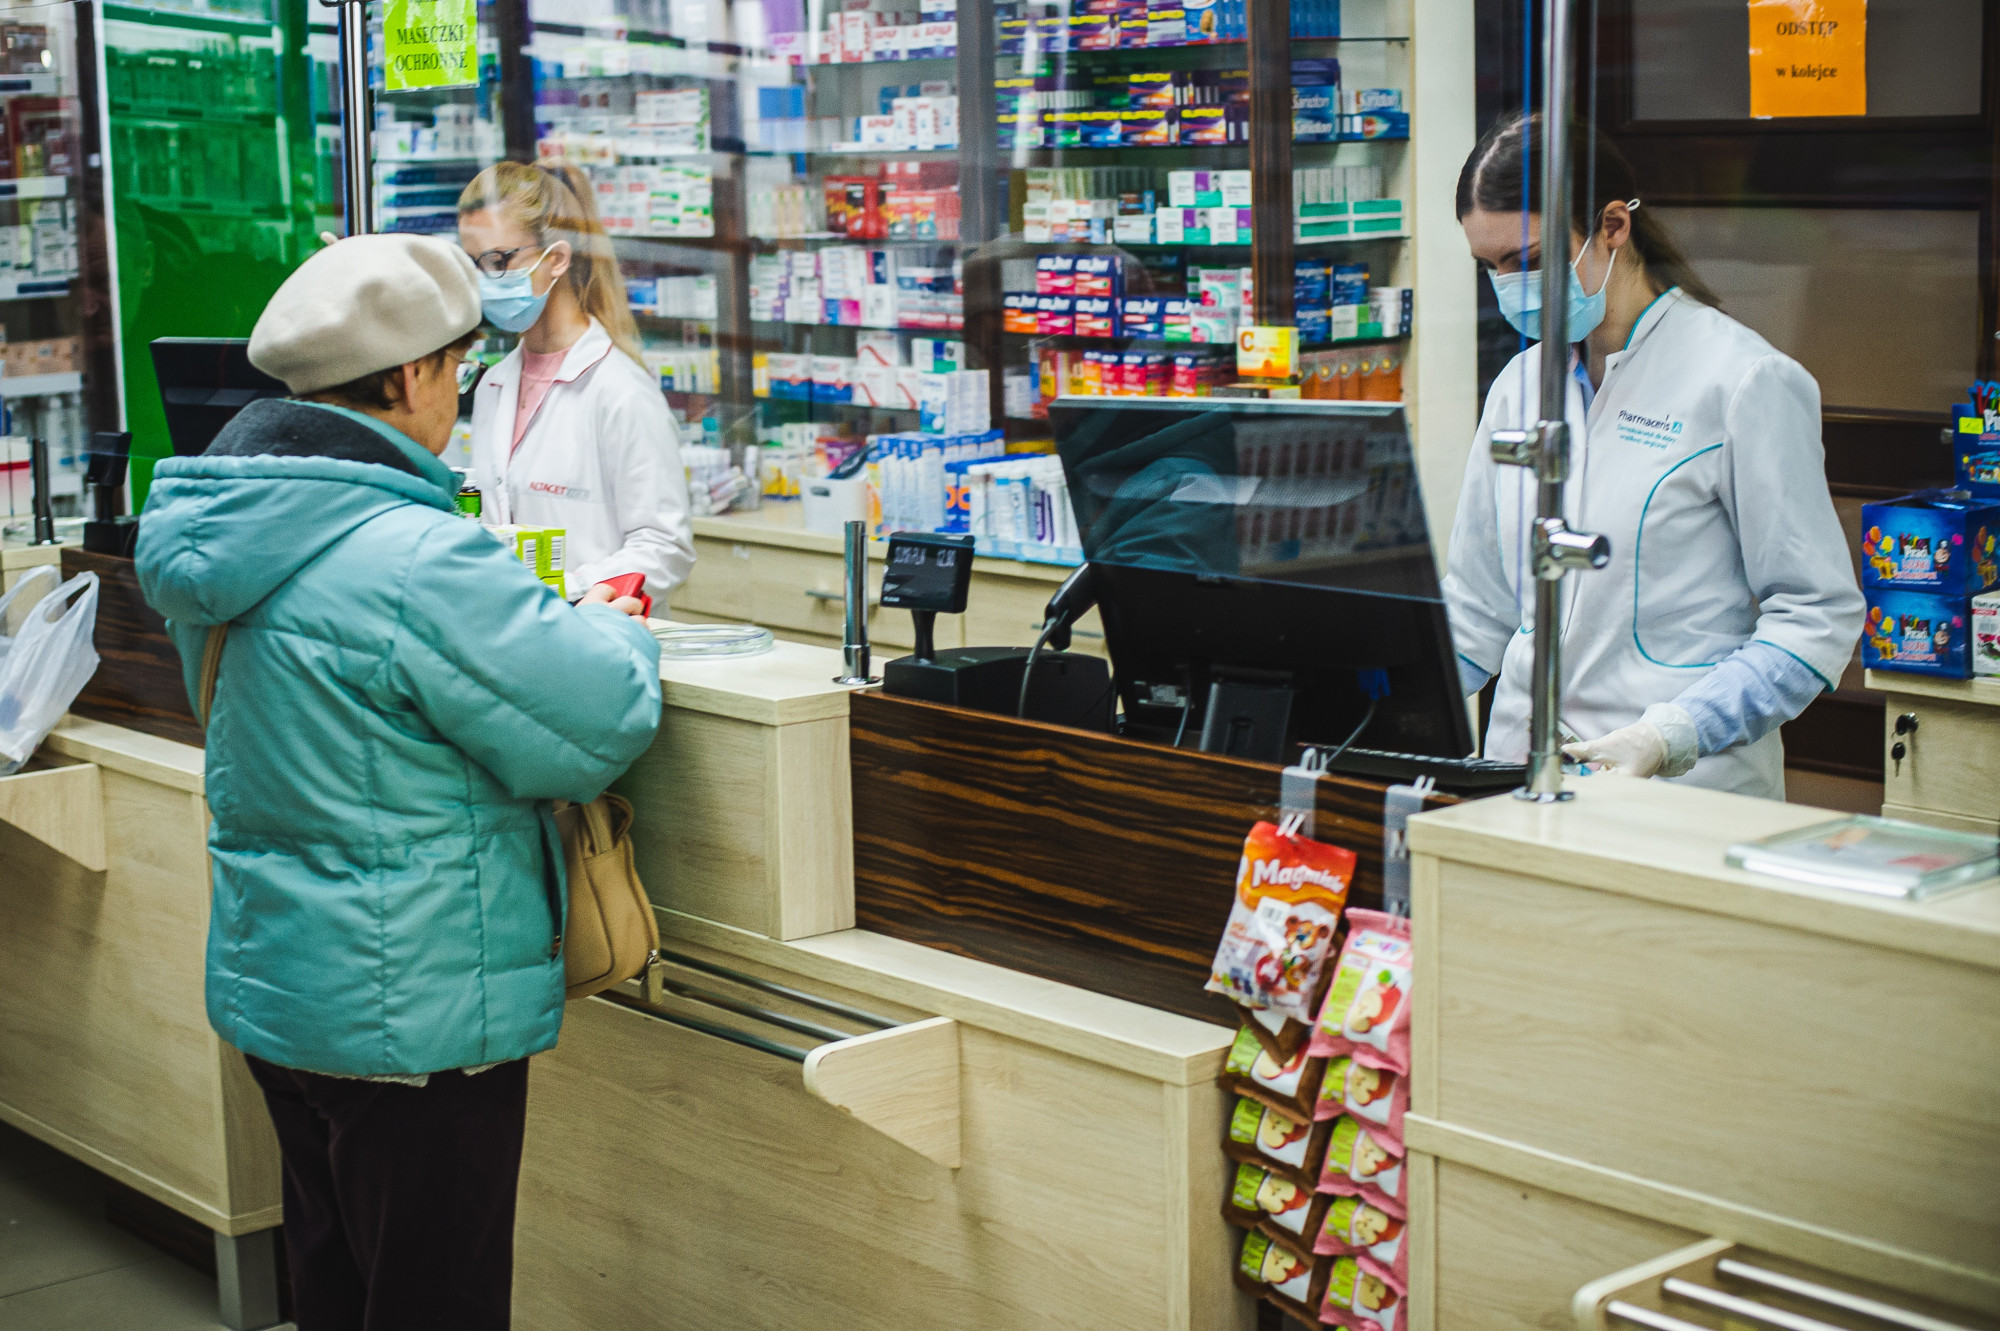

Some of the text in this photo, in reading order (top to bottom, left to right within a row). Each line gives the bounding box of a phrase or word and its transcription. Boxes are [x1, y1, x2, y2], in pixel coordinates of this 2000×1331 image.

[396, 24, 464, 45] MASECZKI
[1776, 21, 1838, 38] ODSTĘP
[395, 51, 468, 71] OCHRONNE
[1776, 64, 1838, 81] w kolejce
[1618, 409, 1670, 432] Pharmaceris
